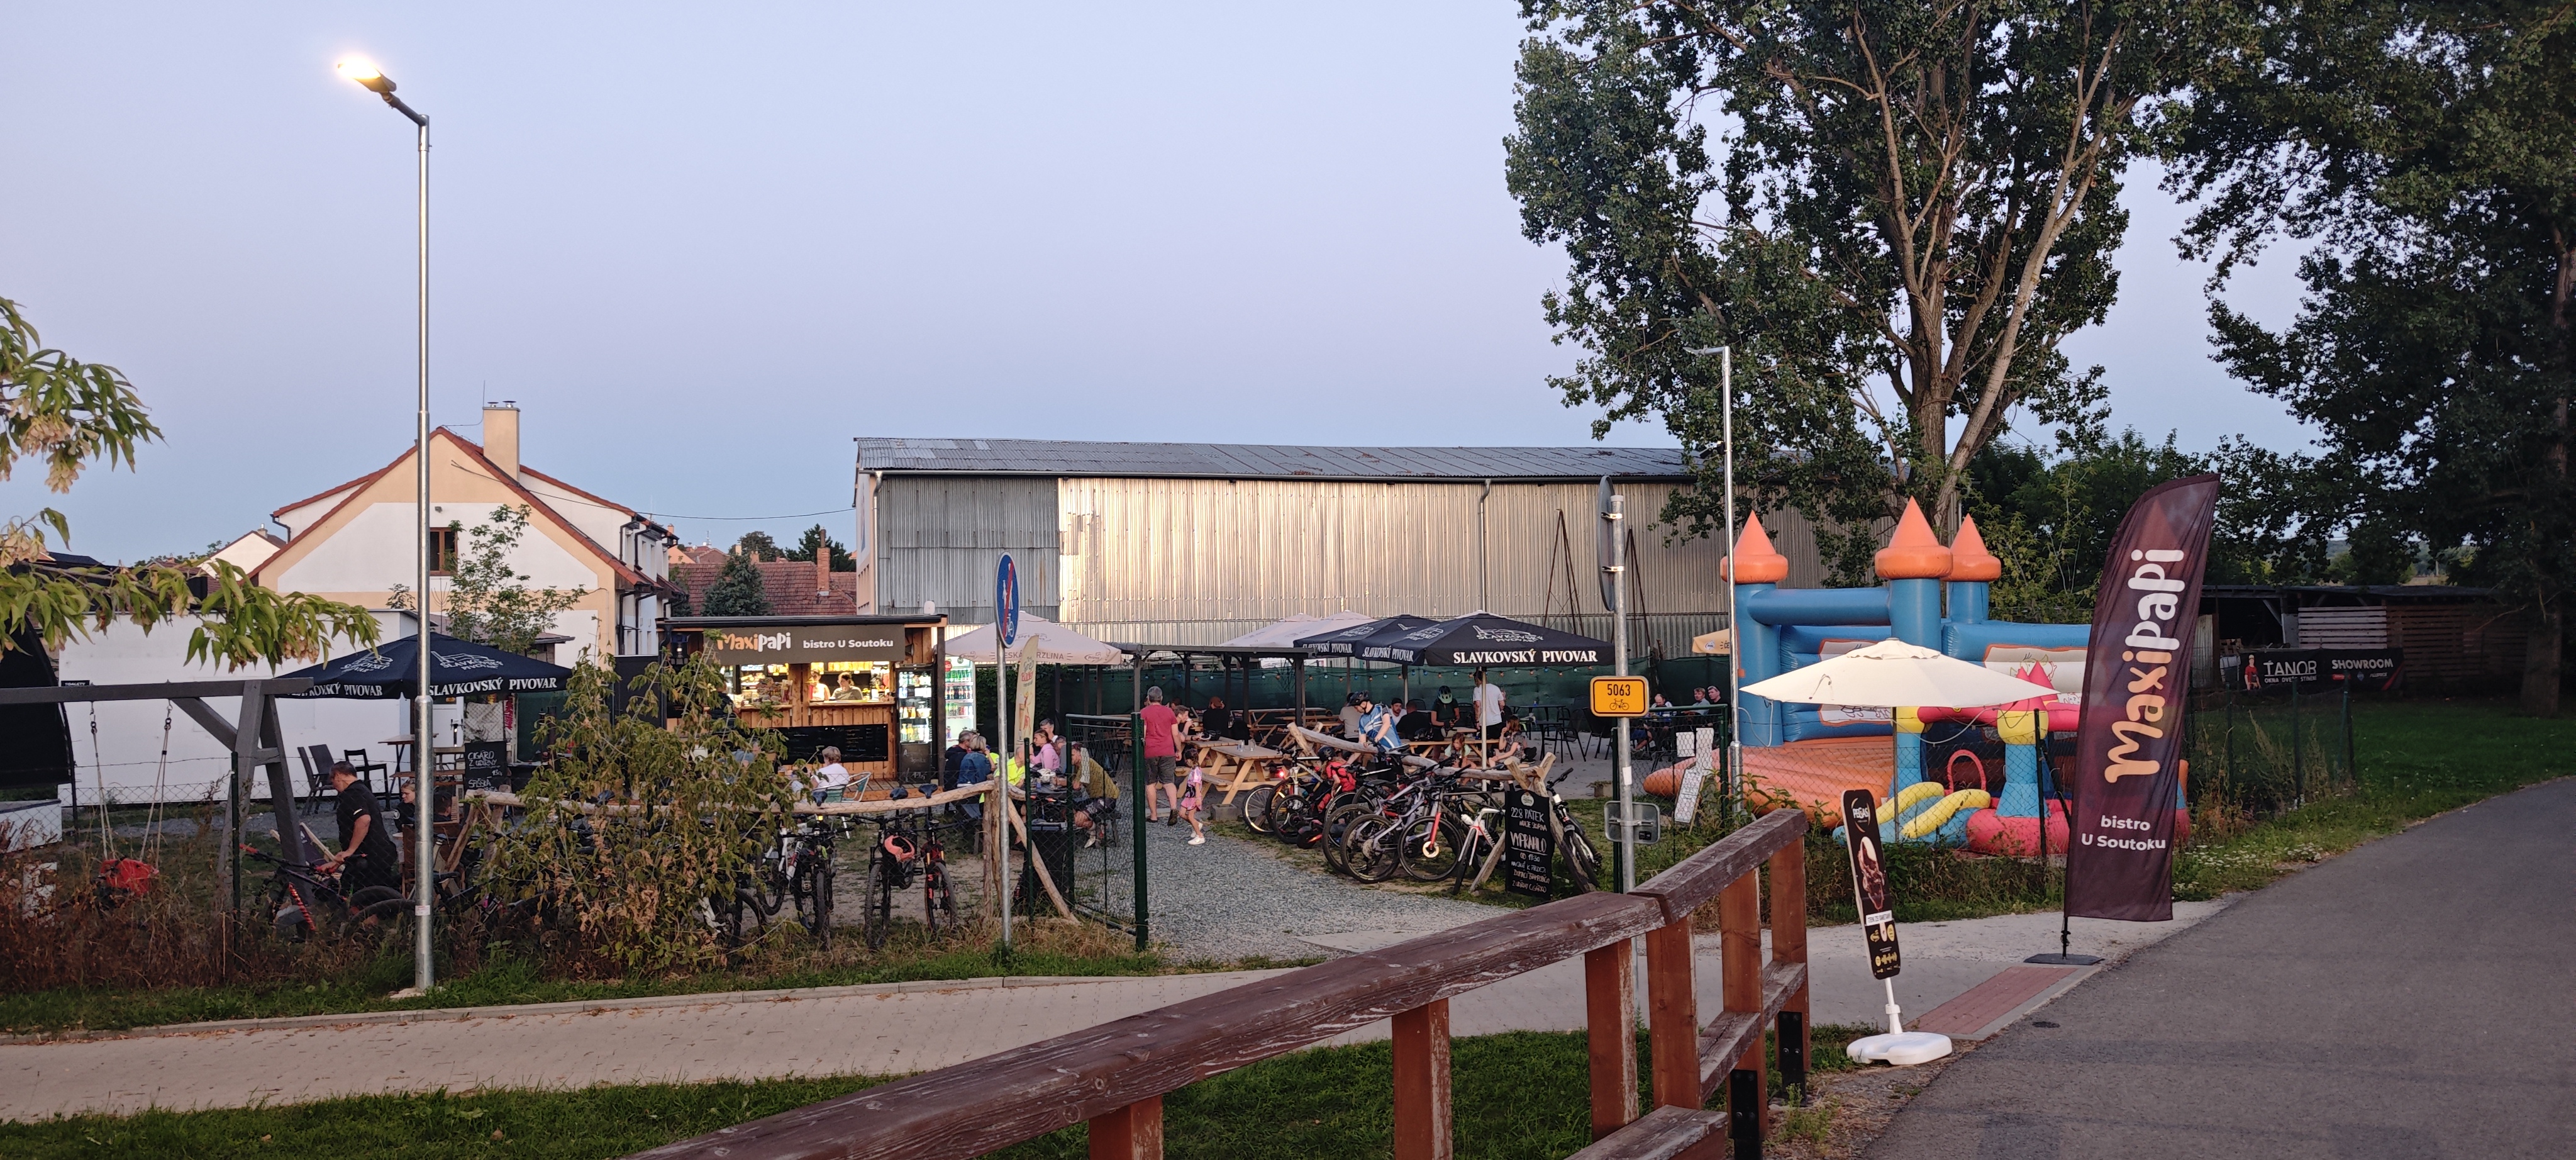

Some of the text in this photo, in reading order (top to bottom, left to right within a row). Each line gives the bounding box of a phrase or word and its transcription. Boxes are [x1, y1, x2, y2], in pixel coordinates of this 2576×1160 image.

[802, 639, 894, 649] bistro U Soutoku
[1331, 643, 1353, 654] PIVOVAR
[1004, 649, 1065, 660] ESKÁ RZLINA
[1362, 645, 1414, 662] SLAVKOVSKÝ PIVOVAR
[1453, 649, 1599, 664] SLAVKOVSKÝ PIVOVAR
[2331, 659, 2394, 669] SHOWROOM
[343, 684, 383, 696] PIVOVAR
[429, 677, 558, 696] SLAVKOVSKÝ PIVOVAR
[1607, 683, 1631, 696] 5063
[2101, 815, 2151, 831] bistro
[2080, 833, 2167, 852] U Soutoku
